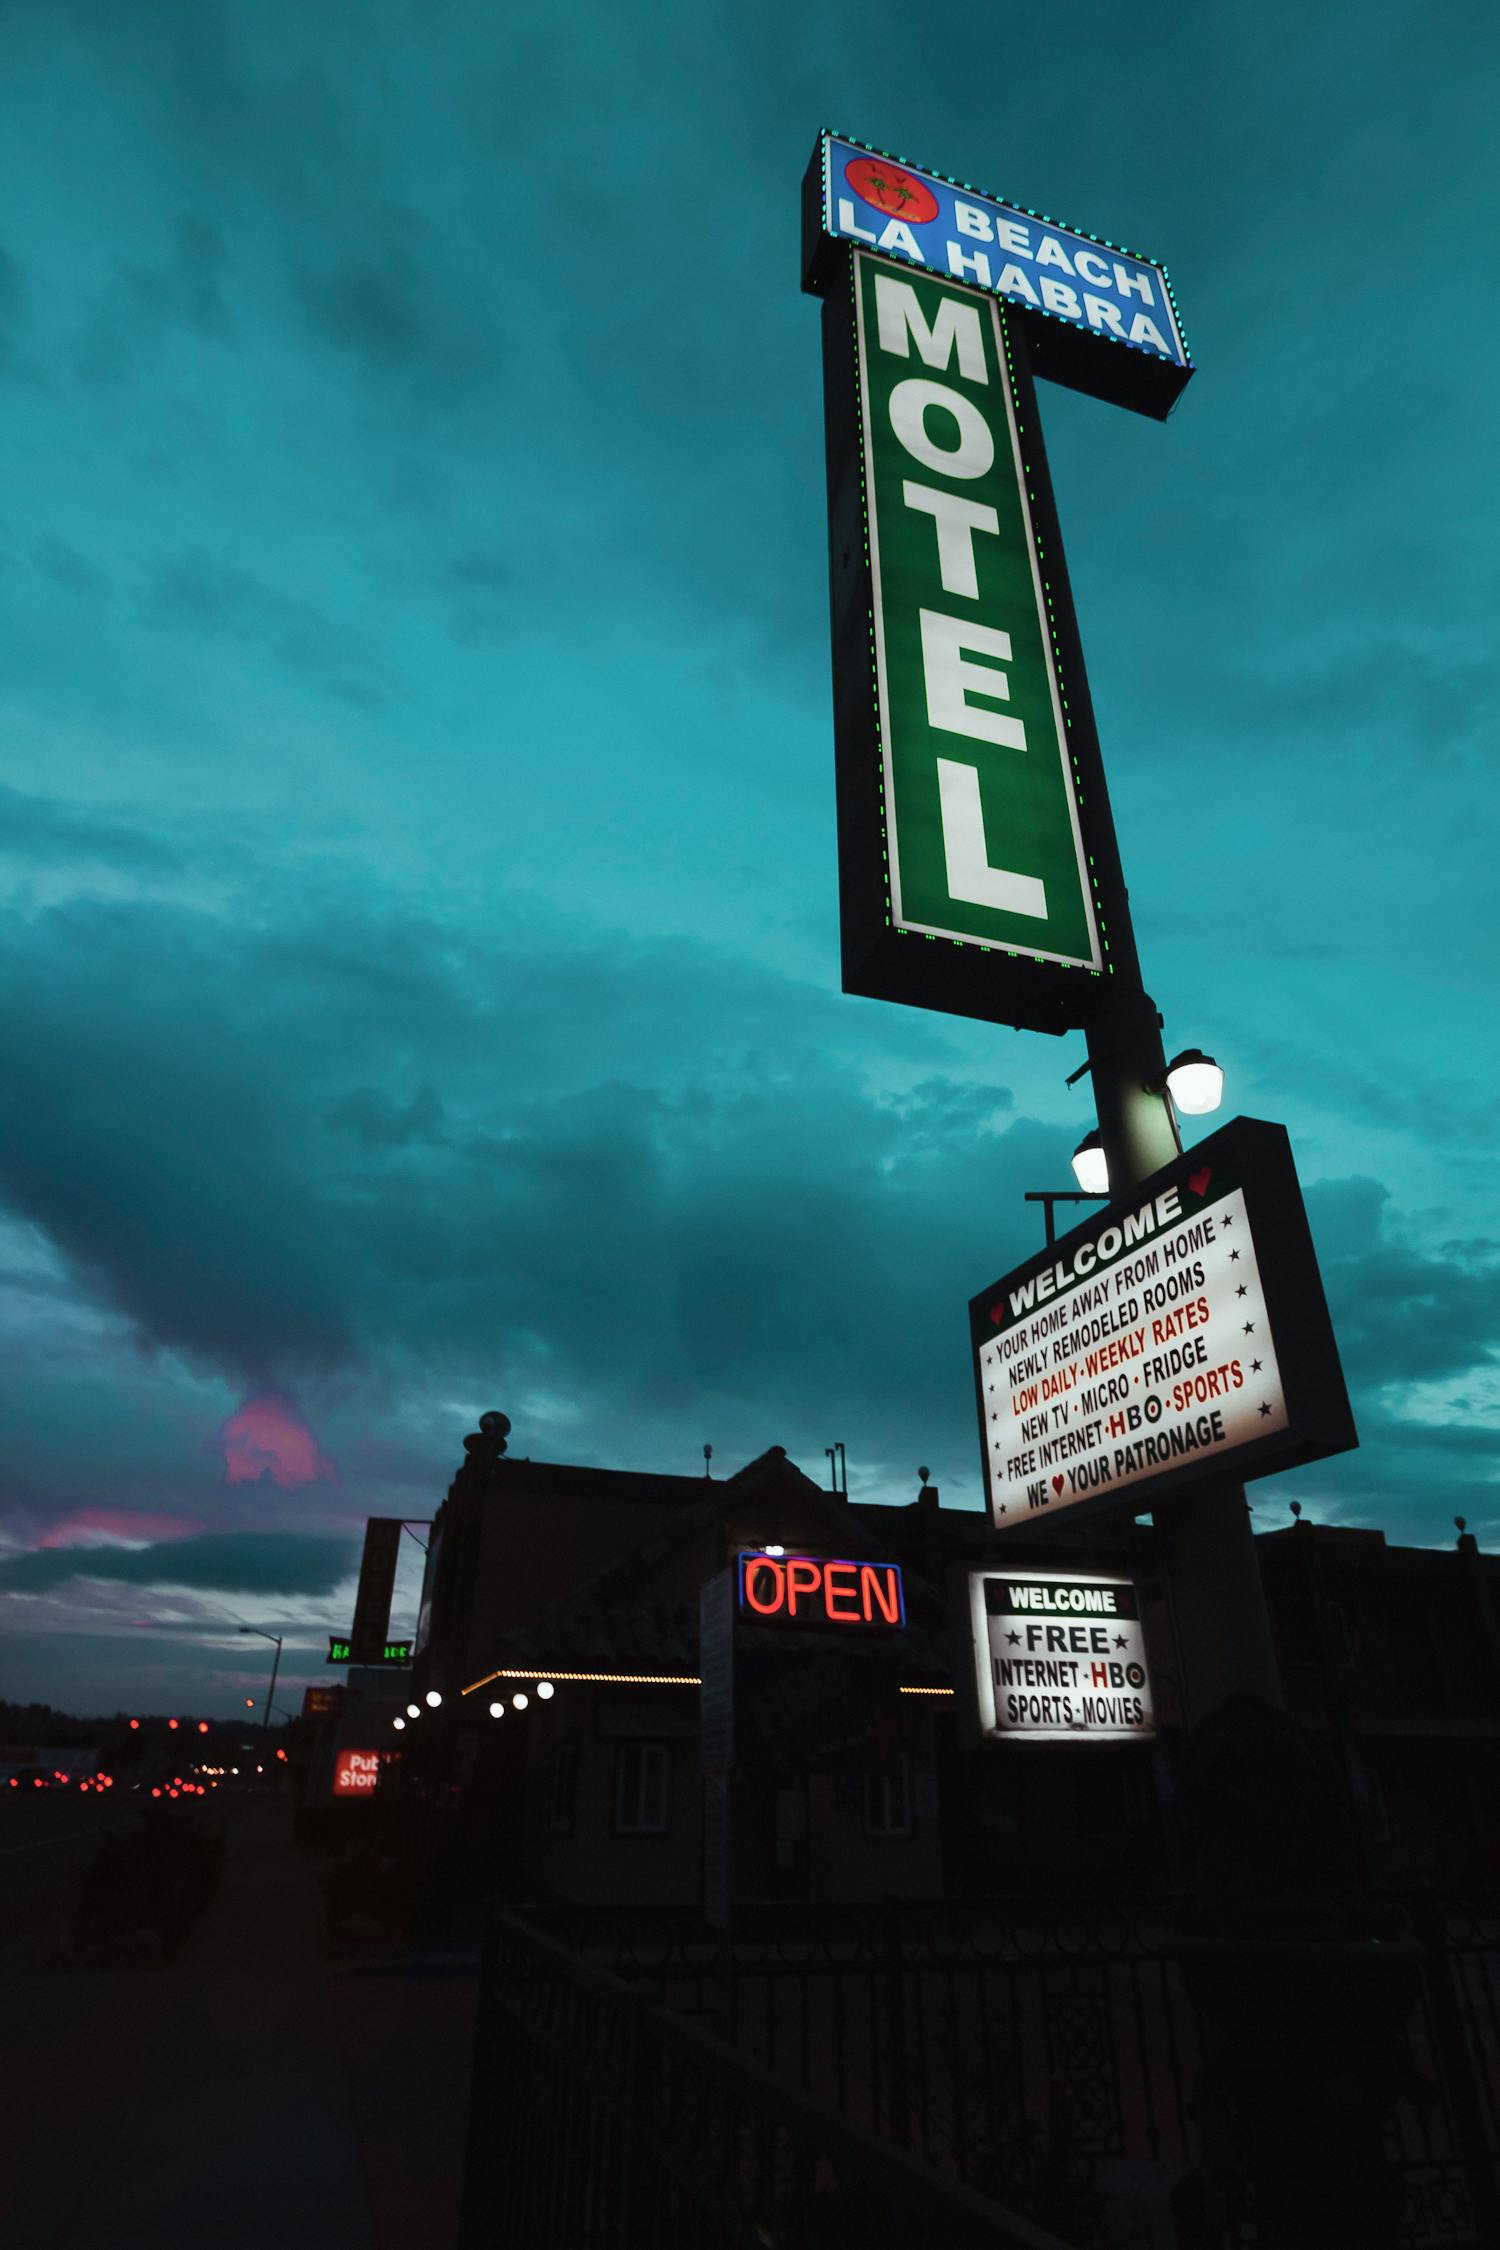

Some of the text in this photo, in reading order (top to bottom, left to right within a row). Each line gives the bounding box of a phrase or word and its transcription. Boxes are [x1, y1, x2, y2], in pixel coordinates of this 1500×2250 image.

[838, 198, 1172, 356] LA HABRA
[954, 200, 1155, 307] BEACH
[874, 273, 1048, 920] MOTEL
[996, 1217, 1216, 1364] YOUR HOME AWAY FROM HOME
[1008, 1186, 1183, 1317] WELCOME
[1008, 1261, 1205, 1388] NEWLY REMODELED ROOMS
[1012, 1384, 1039, 1417] LOW
[1153, 1296, 1210, 1345] RATES
[1007, 1447, 1036, 1482] FREE
[1040, 1420, 1103, 1469] INTERNET
[1173, 1360, 1244, 1411] SPORTS
[1022, 1336, 1208, 1444] NEW TV MICRO FRIDGE
[1027, 1410, 1226, 1509] WE YOUR PATRONAGE
[745, 1558, 898, 1623] OPEN
[1009, 1587, 1117, 1612] WELCOME
[1026, 1624, 1111, 1654] FREE
[994, 1659, 1146, 1689] INTERNET HBO
[1007, 1694, 1144, 1724] SPORTS MOVIES
